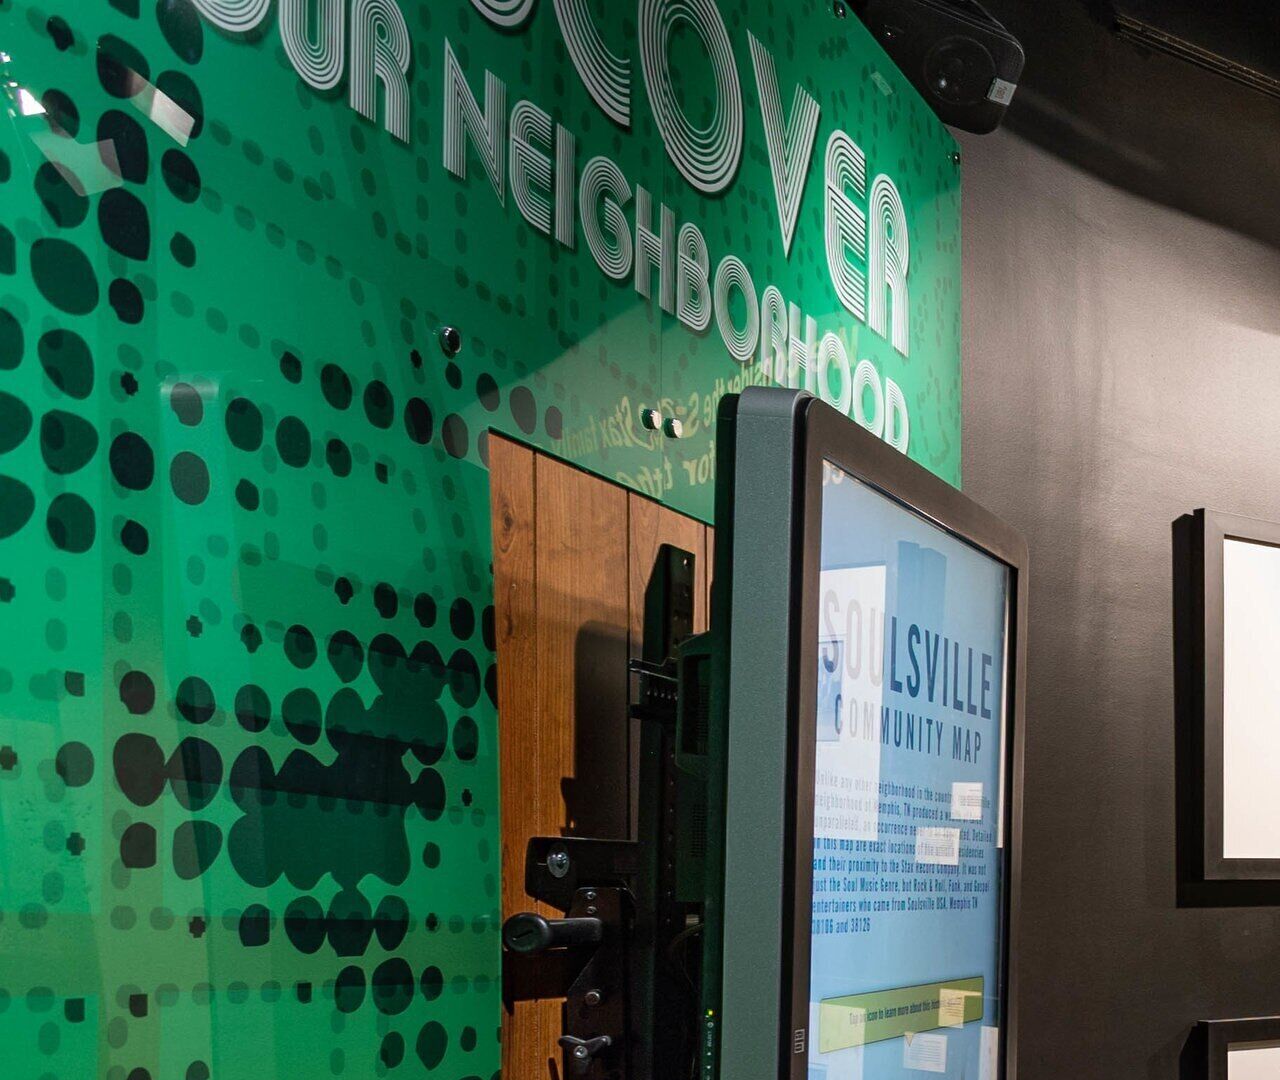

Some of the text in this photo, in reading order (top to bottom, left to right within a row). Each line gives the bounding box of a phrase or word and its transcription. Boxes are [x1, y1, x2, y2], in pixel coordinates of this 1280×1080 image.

[471, 0, 909, 357] COVER
[442, 36, 909, 454] NEIGHBORHOOD
[822, 589, 992, 720] SOULSVILLE
[834, 694, 982, 765] COMMUNITY MAP
[875, 780, 915, 799] eighborhood
[812, 878, 827, 892] ust
